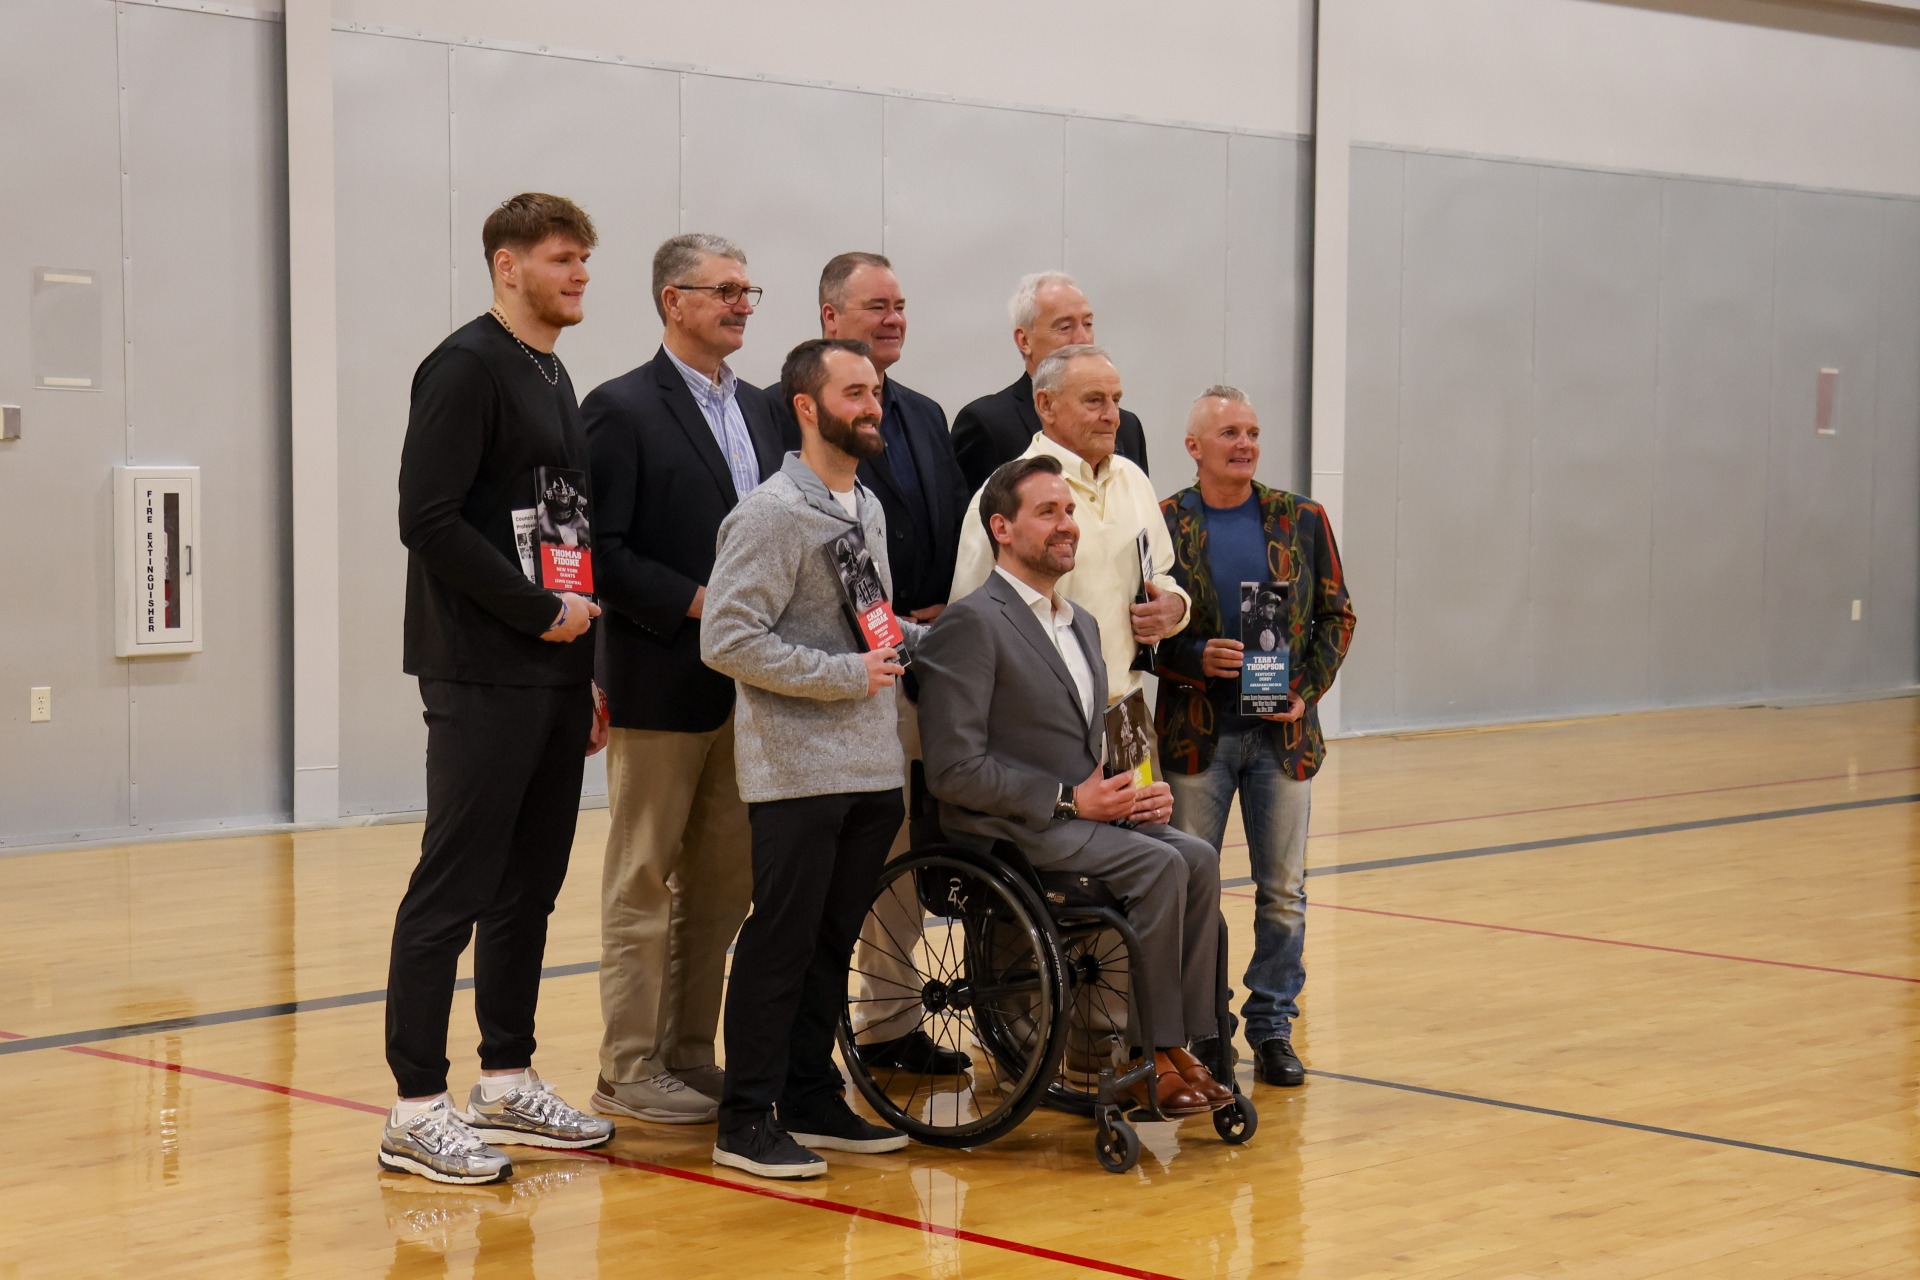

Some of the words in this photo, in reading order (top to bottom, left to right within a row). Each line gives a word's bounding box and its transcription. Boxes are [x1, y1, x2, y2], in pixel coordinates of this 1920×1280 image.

[550, 549, 582, 560] THOMAS
[553, 556, 580, 567] FIDONE
[147, 532, 155, 632] EXTINGUISHER
[433, 1102, 445, 1112] NIKE
